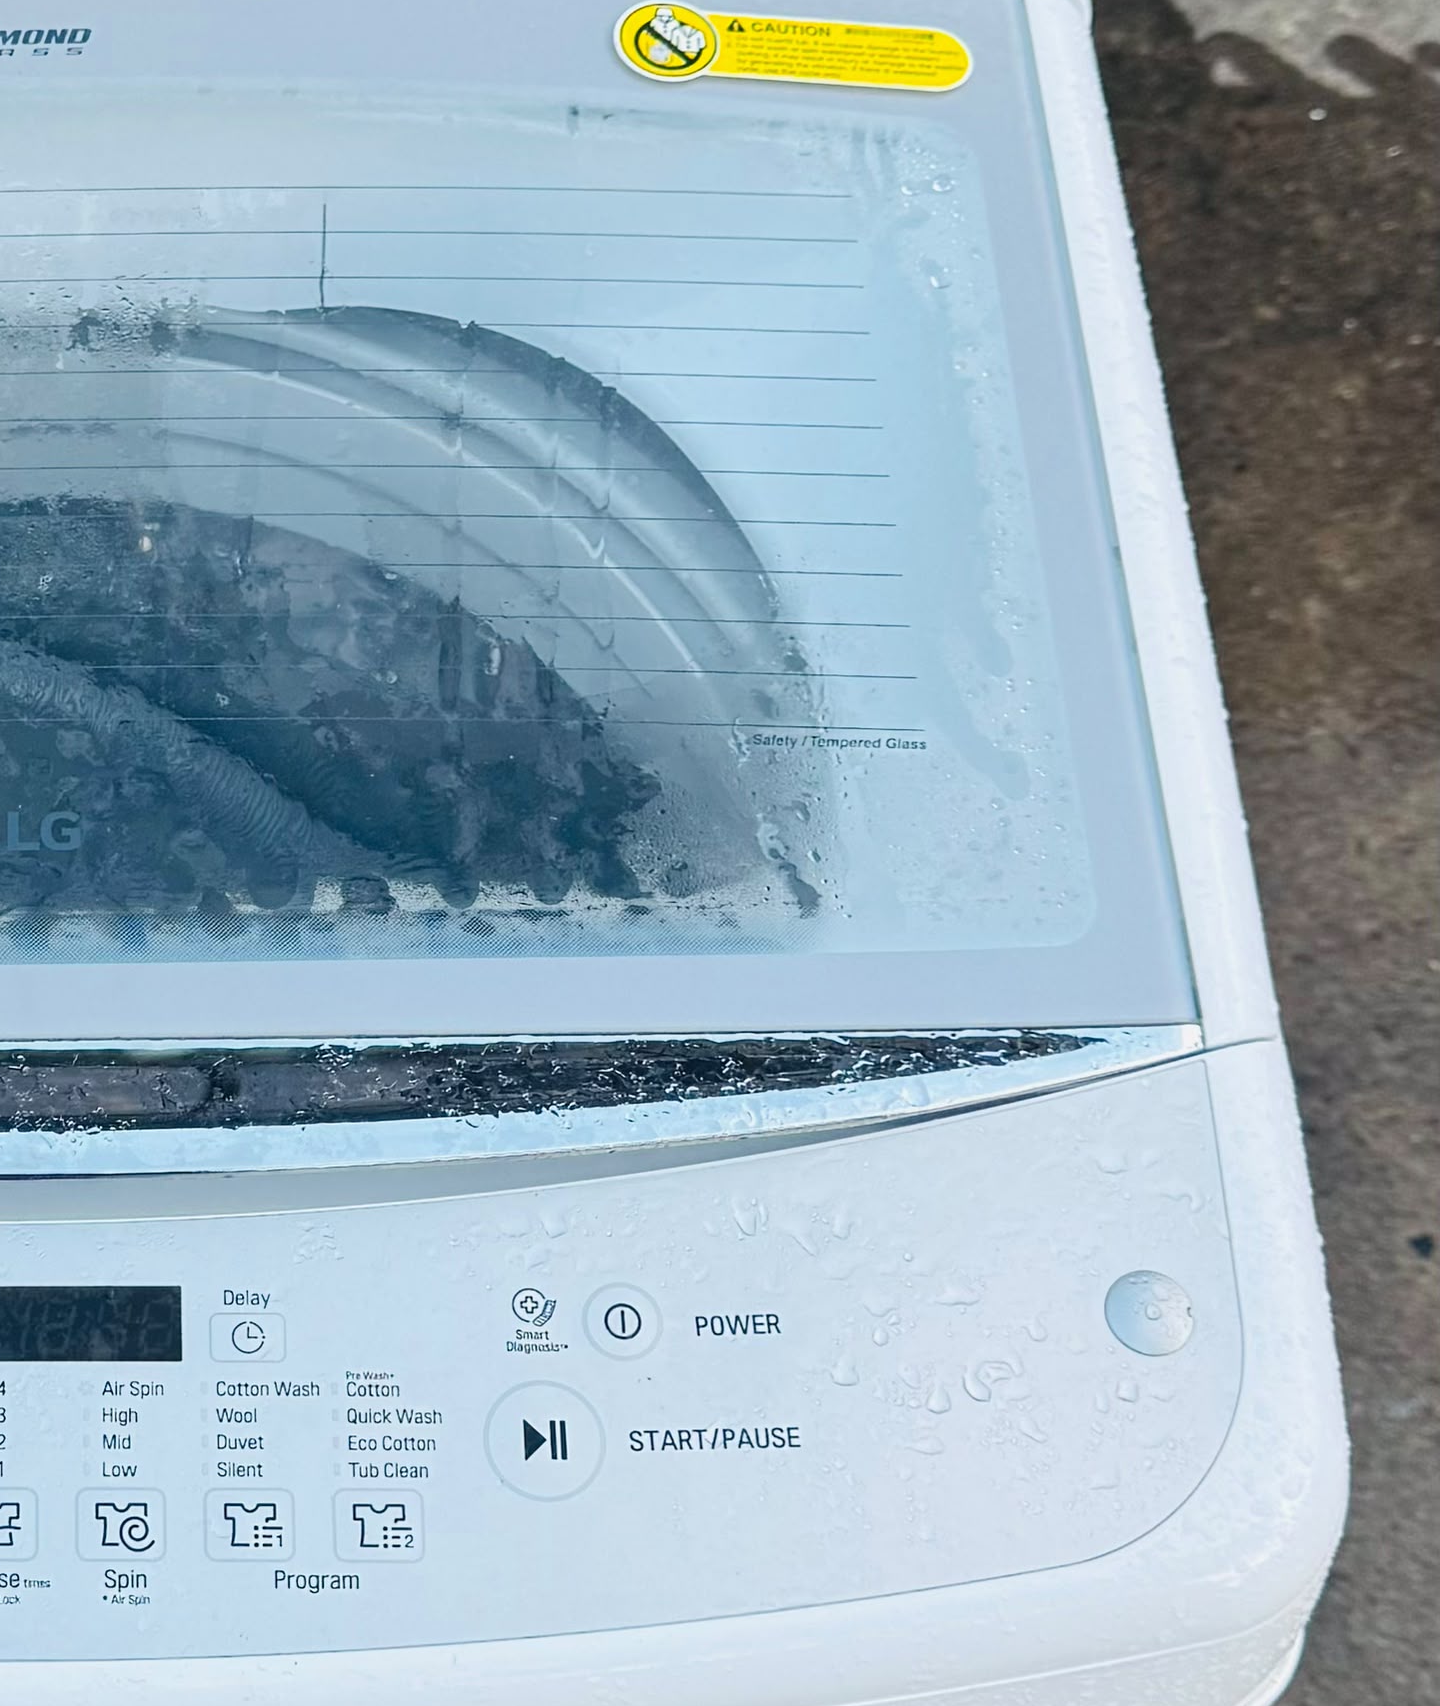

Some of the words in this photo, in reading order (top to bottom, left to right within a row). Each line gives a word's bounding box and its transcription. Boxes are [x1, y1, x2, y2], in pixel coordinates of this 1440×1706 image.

[751, 22, 831, 37] CAUTION
[752, 733, 797, 749] Safety
[810, 735, 881, 750] Tempered
[886, 738, 927, 750] Glass
[7, 810, 83, 852] LG
[223, 1289, 271, 1309] Delay
[695, 1313, 782, 1337] POWER
[515, 1329, 549, 1340] Smart
[346, 1371, 361, 1380] Pre
[102, 1381, 125, 1396] Air
[129, 1381, 165, 1399] Spin
[216, 1381, 270, 1397] Cotton
[274, 1381, 320, 1397] Wash
[346, 1381, 400, 1397] Cotton
[102, 1408, 138, 1426] High
[216, 1408, 258, 1424] Wool
[347, 1408, 392, 1425] Quick
[396, 1409, 443, 1424] Wash
[102, 1434, 131, 1450] Mid
[216, 1434, 265, 1451] Duvet
[348, 1435, 378, 1451] Eco
[382, 1435, 436, 1452] Cotton
[629, 1426, 802, 1452] START/PAUSE
[102, 1461, 137, 1477] Low
[216, 1462, 264, 1478] Silent
[348, 1462, 379, 1478] Tub
[384, 1462, 429, 1479] Clean
[404, 1534, 415, 1548] 2
[104, 1569, 148, 1592] Spin
[274, 1570, 360, 1594] Program
[111, 1594, 126, 1605] Air
[128, 1595, 151, 1606] Spin
